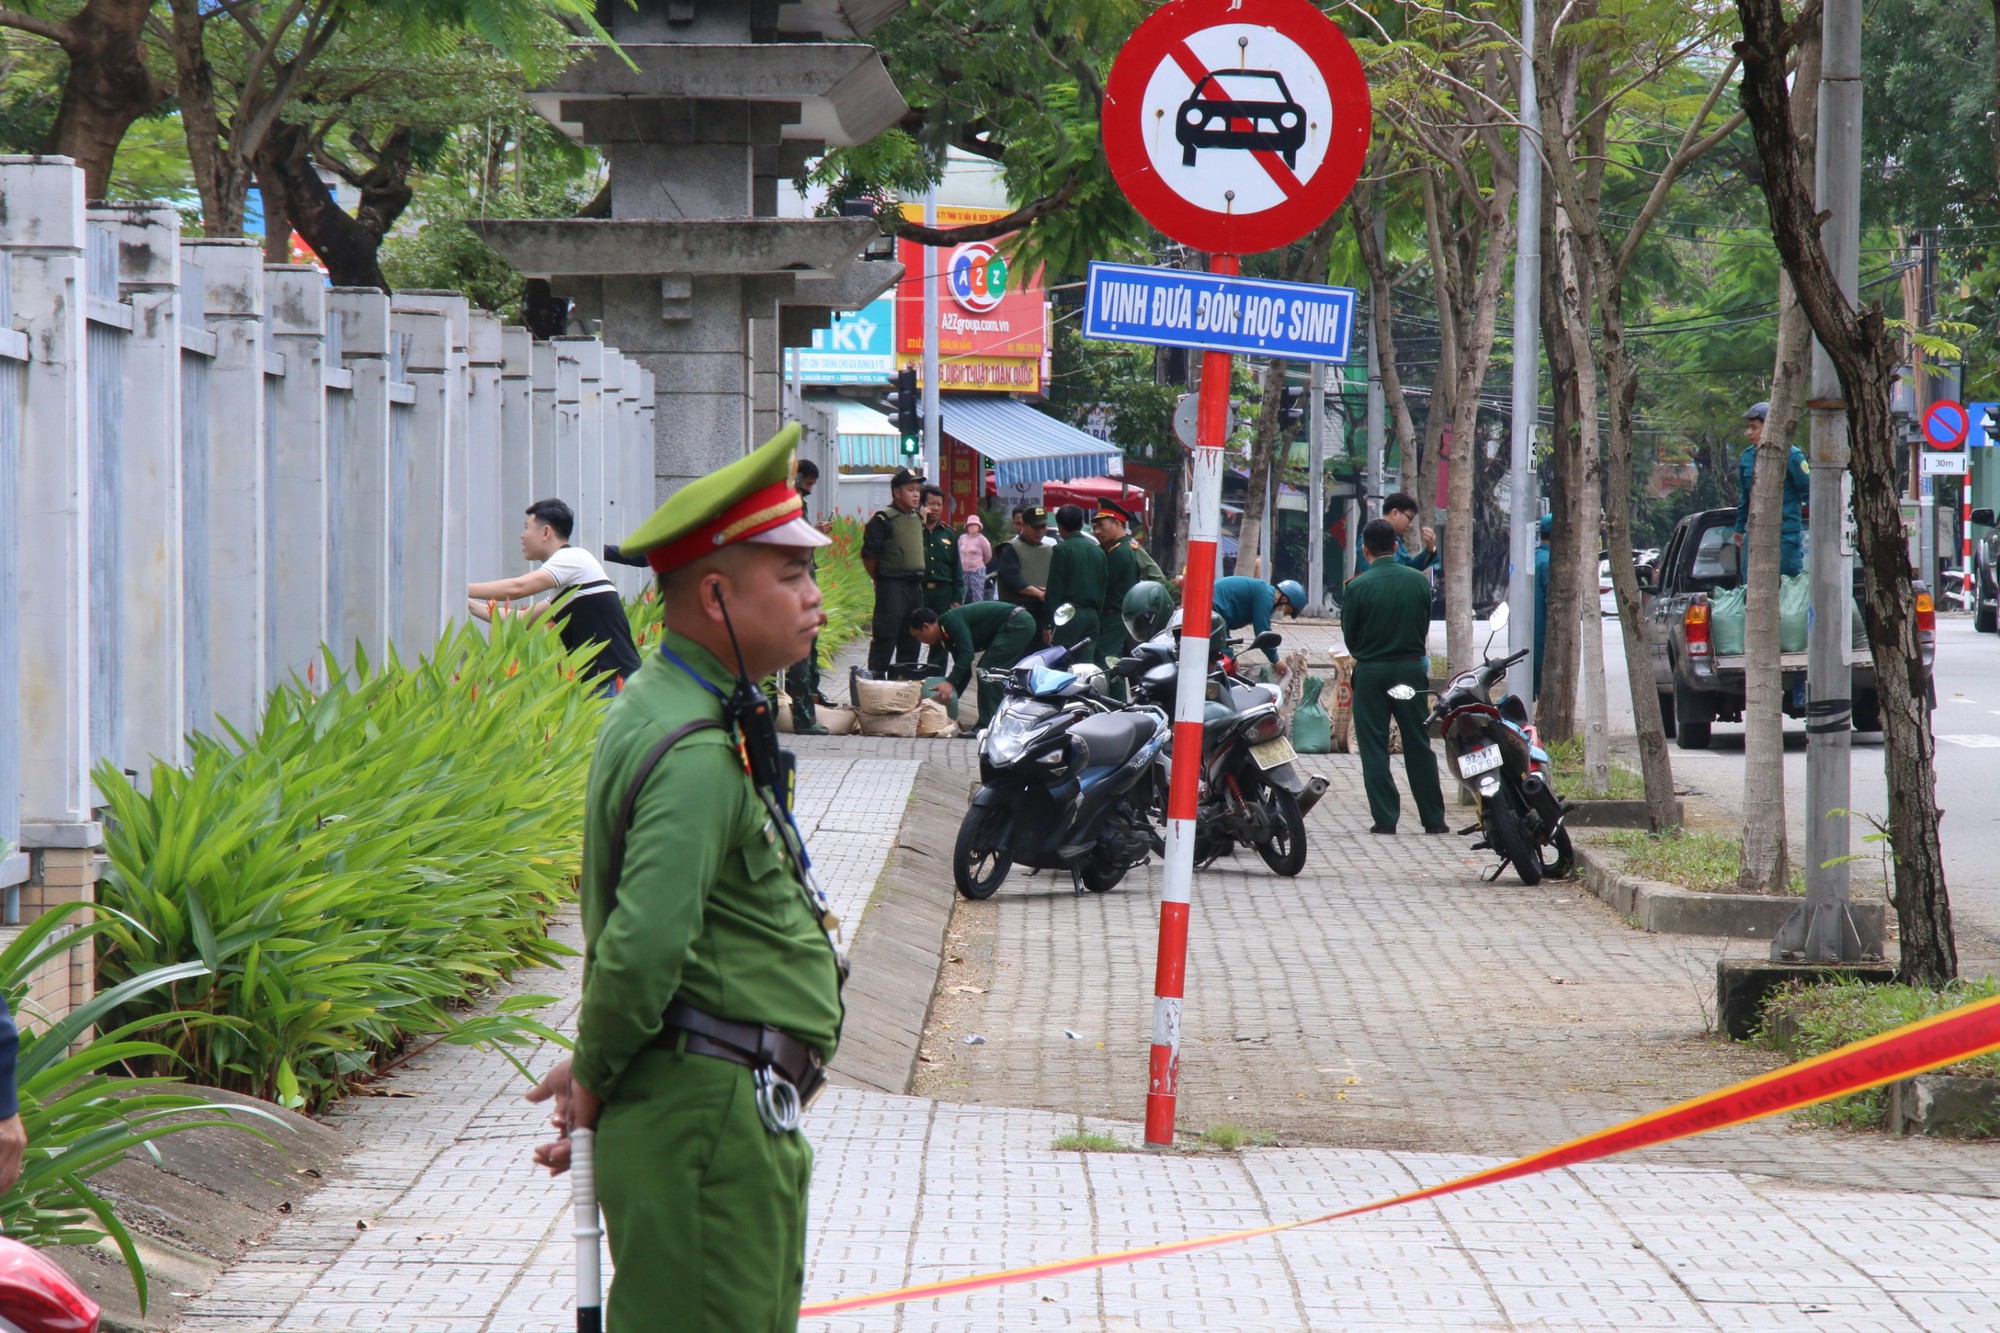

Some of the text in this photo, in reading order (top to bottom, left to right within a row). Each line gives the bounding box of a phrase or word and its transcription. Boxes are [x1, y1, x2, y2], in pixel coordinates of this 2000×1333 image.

[959, 266, 1000, 286] A2Z
[1100, 280, 1340, 346] VỊNH ĐƯA ĐÓN HỌC SINH
[832, 317, 877, 350] KỲ
[941, 313, 1010, 335] A2Zgroup.com.vn
[1935, 459, 1954, 468] 30m
[1464, 756, 1500, 777] 002.89
[1465, 747, 1493, 766] 92-V1
